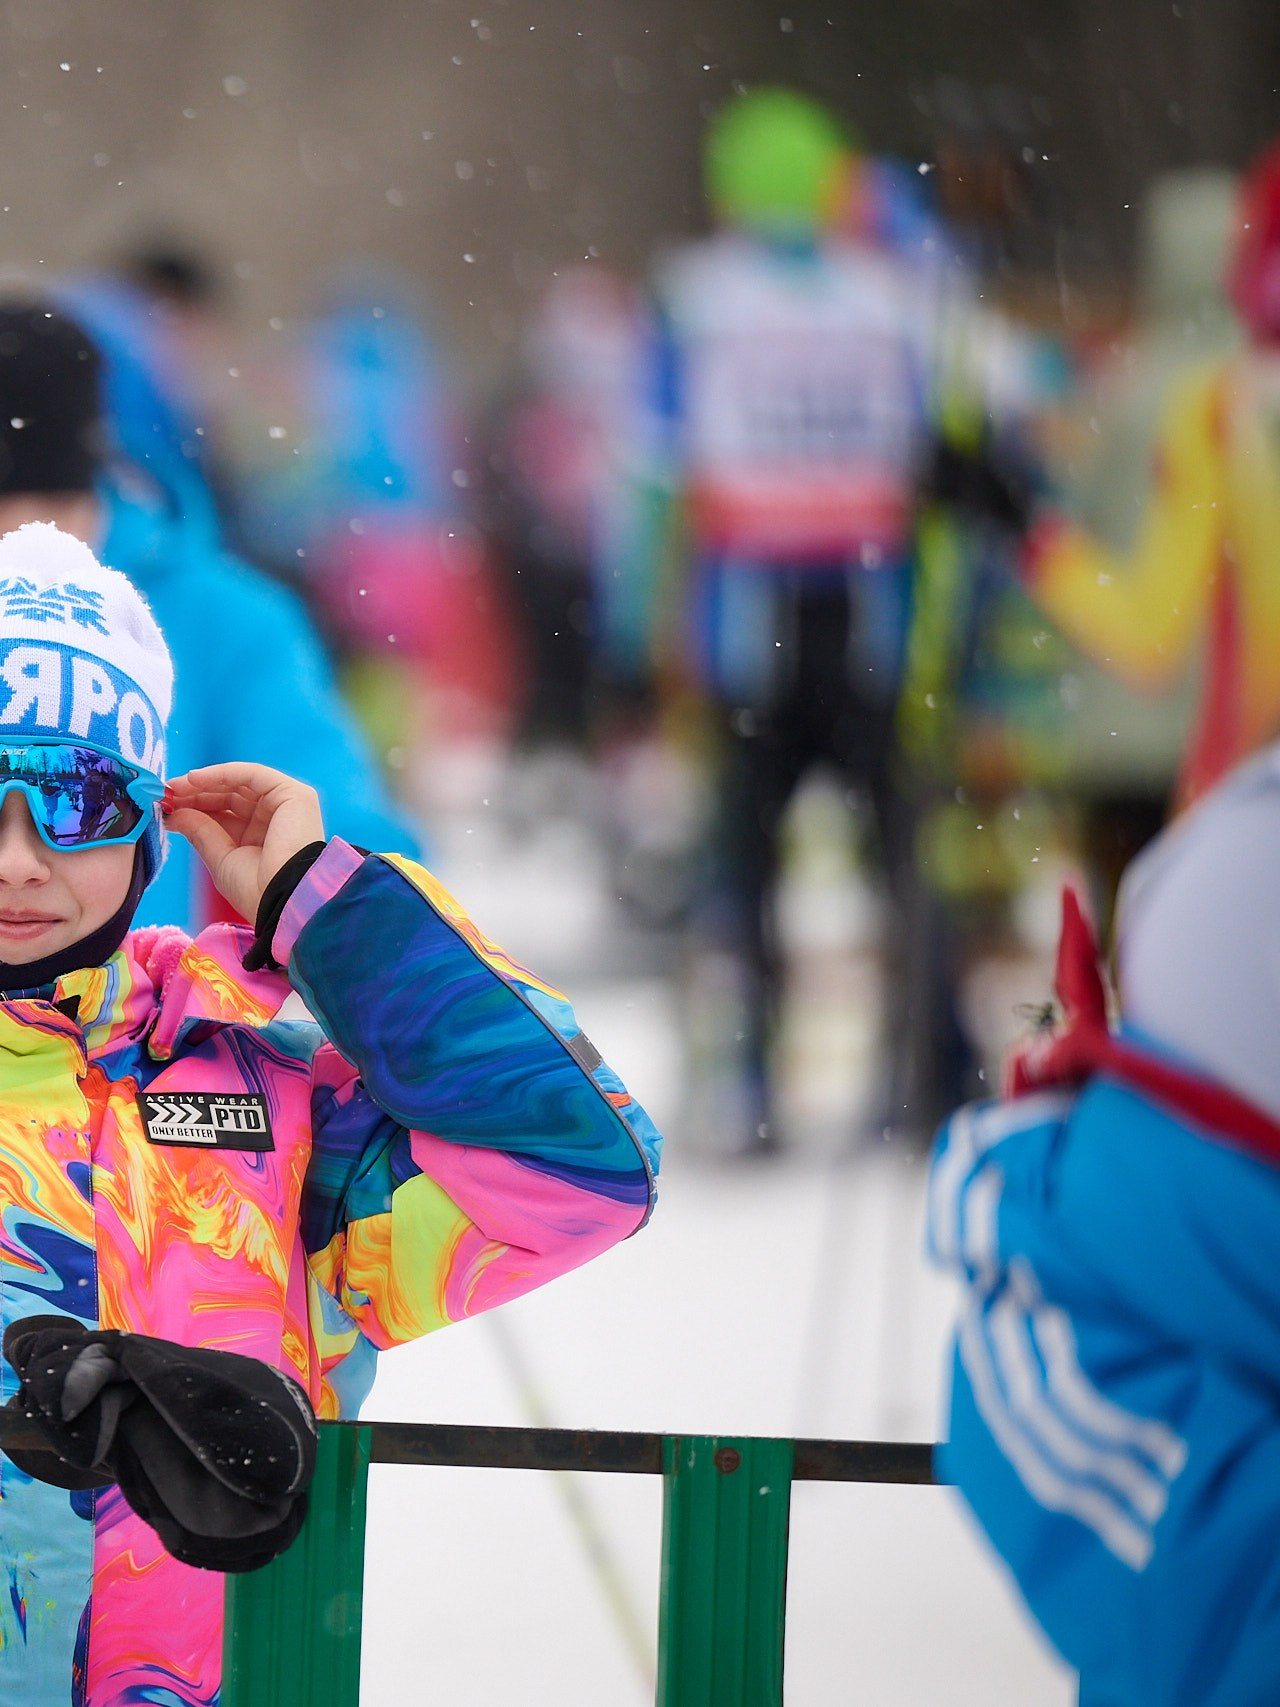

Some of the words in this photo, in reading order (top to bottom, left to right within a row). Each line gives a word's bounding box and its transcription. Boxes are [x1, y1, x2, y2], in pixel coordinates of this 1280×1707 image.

[146, 1095, 205, 1104] ACTIVE
[215, 1097, 258, 1105] WEAR
[215, 1108, 261, 1129] PTD
[152, 1126, 174, 1136] ONLY
[177, 1128, 213, 1138] BETTER
